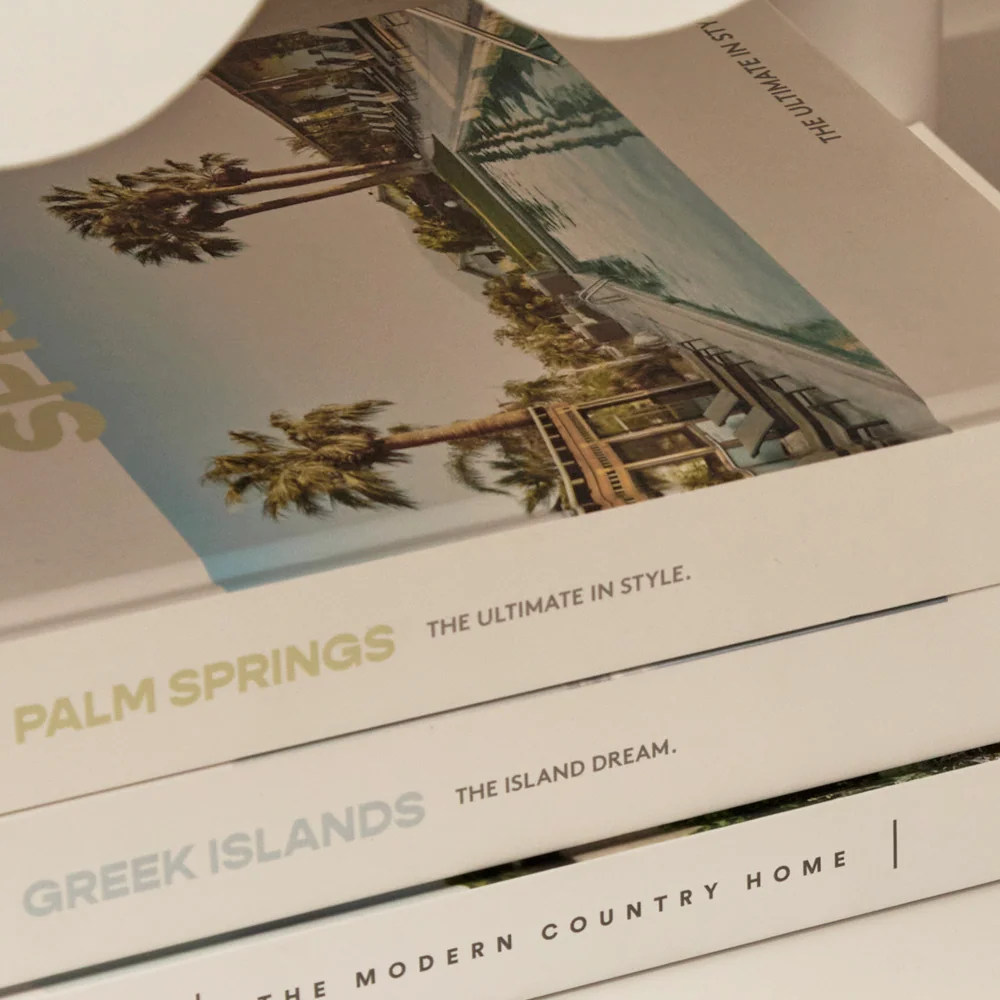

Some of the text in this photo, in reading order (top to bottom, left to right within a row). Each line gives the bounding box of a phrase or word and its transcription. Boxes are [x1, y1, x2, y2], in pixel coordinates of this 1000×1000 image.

[720, 42, 751, 58] IN
[737, 57, 813, 118] ULTIMATE
[801, 116, 842, 144] THE
[426, 565, 692, 638] THE ULTIMATE IN STYLE.
[13, 625, 396, 744] PALM SPRINGS
[455, 739, 677, 805] THE ISLAND DREAM.
[22, 790, 426, 917] GREEK ISLANDS
[355, 934, 513, 988] MODERN
[541, 882, 719, 941] COUNTRY
[746, 850, 846, 890] HOME
